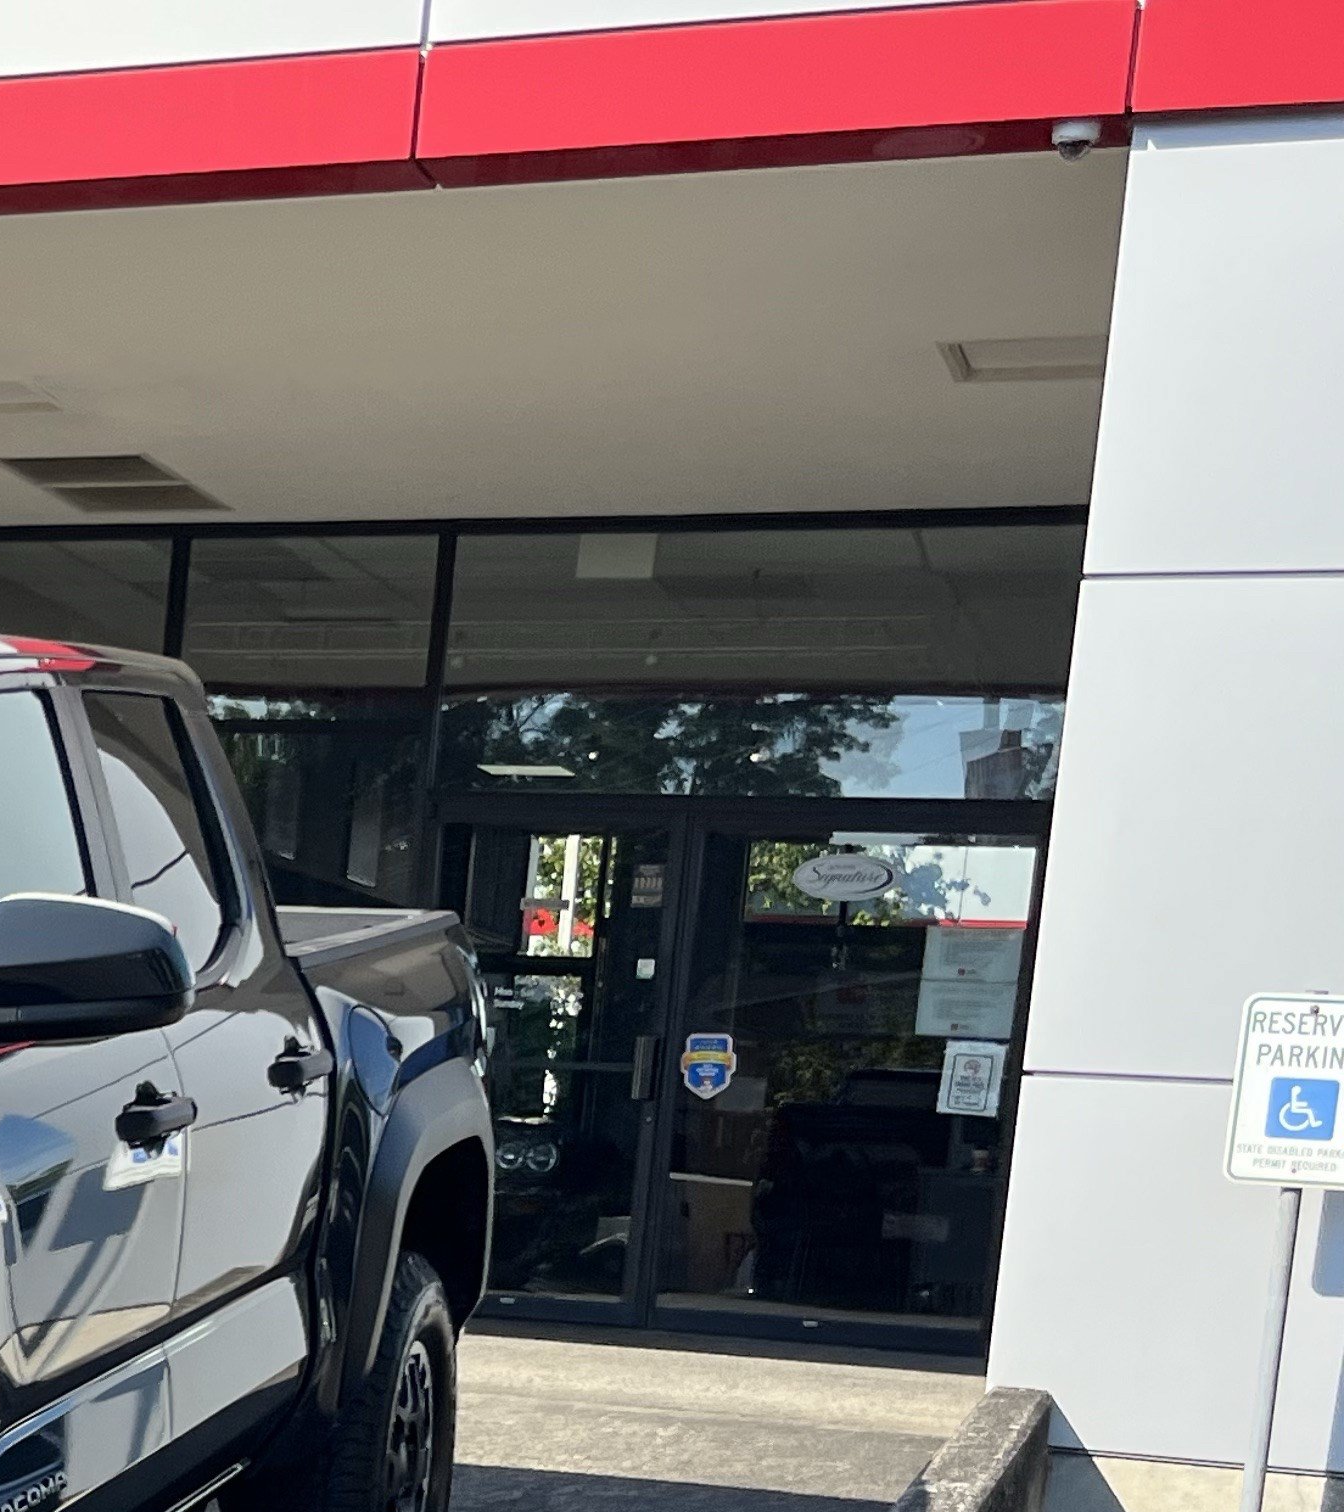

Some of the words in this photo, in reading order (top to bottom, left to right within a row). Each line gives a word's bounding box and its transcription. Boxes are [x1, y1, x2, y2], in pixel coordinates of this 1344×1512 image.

[1236, 1143, 1263, 1154] STATE
[1267, 1144, 1313, 1157] DISABLED
[1252, 1157, 1286, 1169] PERMIT
[1291, 1159, 1337, 1172] REQUIRED
